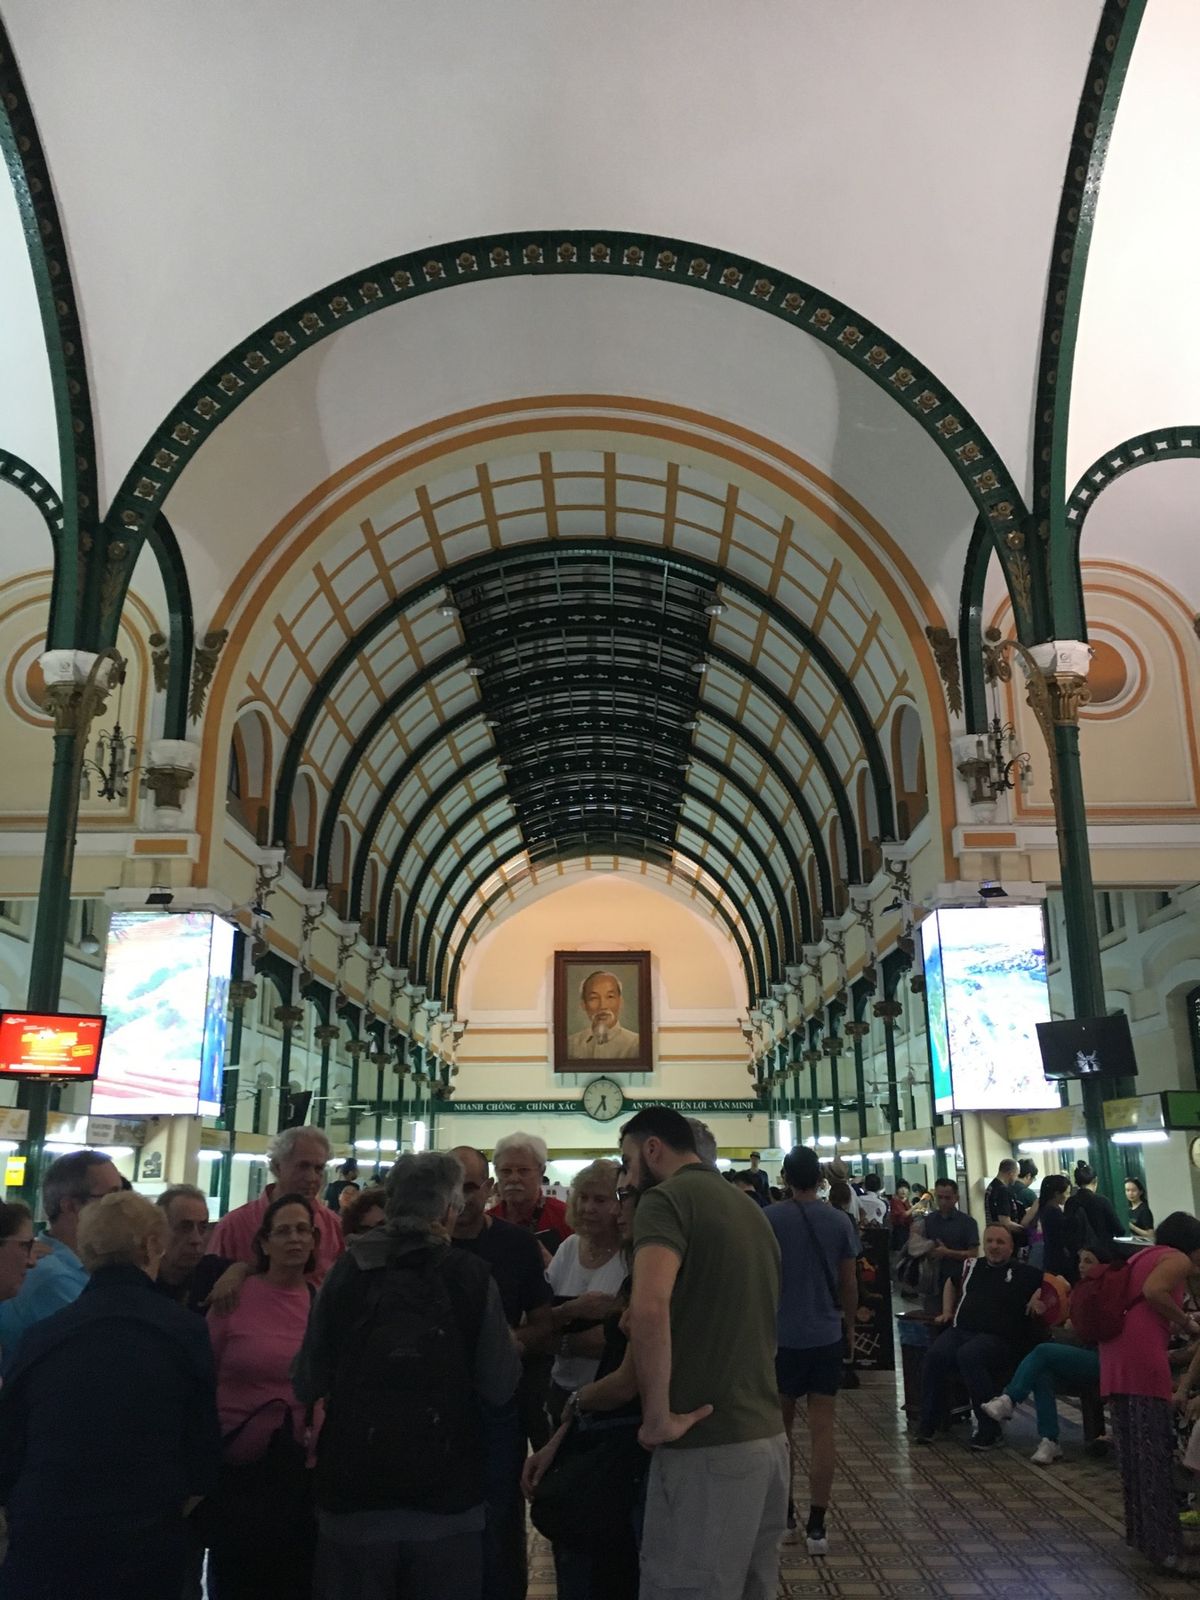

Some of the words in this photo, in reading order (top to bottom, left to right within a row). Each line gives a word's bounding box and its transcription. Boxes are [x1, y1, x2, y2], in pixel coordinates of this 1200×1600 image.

[454, 1103, 483, 1111] NHANH
[486, 1101, 516, 1111] CHÓNG
[526, 1101, 555, 1110] CHÍNH
[557, 1101, 577, 1110] XÁC
